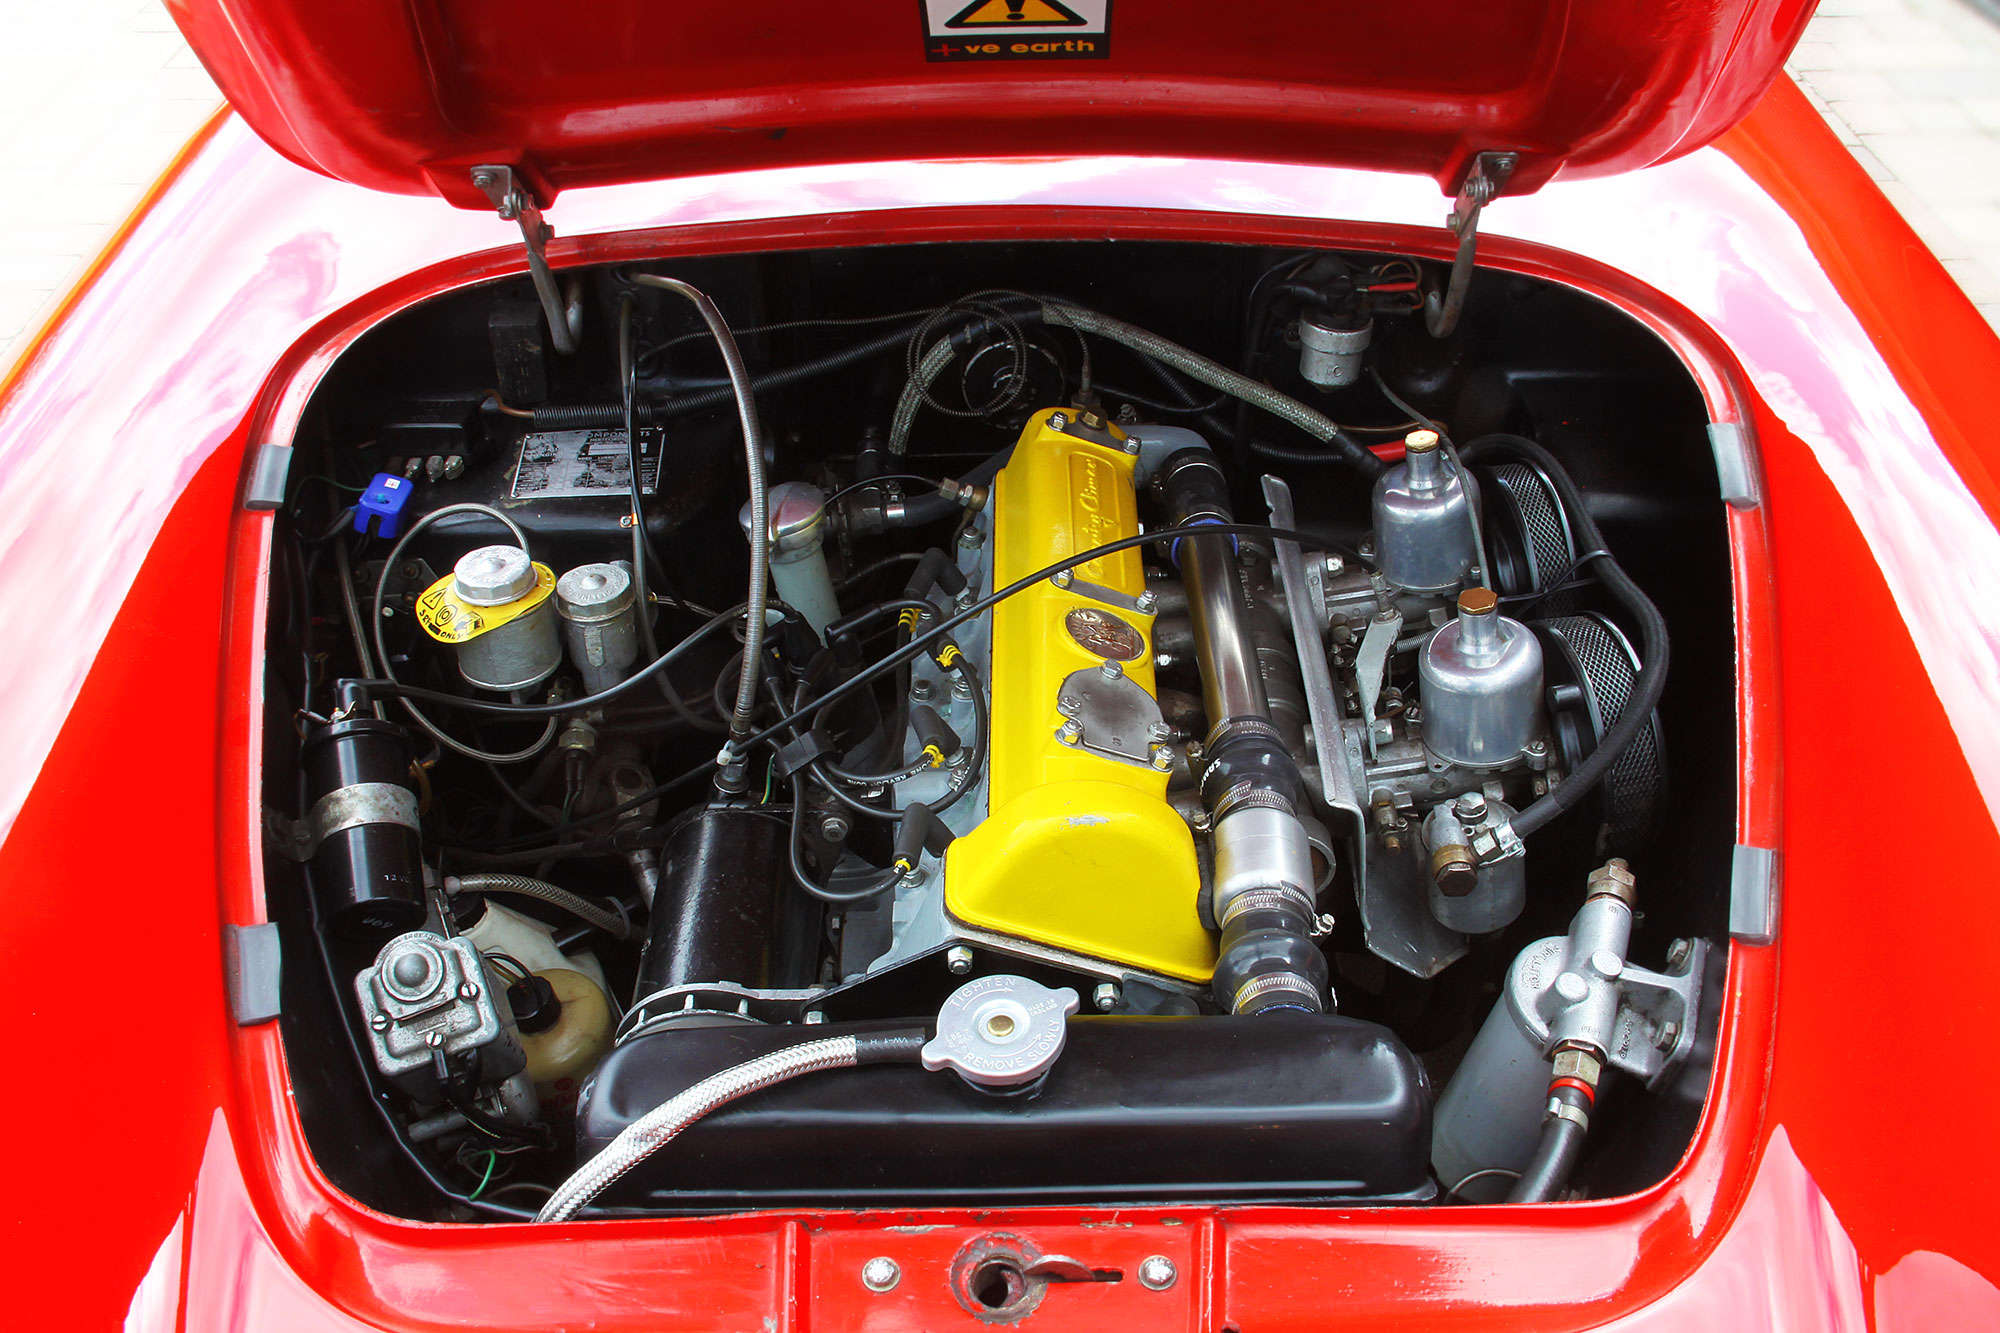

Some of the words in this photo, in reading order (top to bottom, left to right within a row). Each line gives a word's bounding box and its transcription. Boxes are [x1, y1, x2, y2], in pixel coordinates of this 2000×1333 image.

[1010, 40, 1095, 54] earth
[948, 976, 1017, 1007] TIGHTEN
[963, 1052, 1028, 1071] REMOVE
[1029, 1016, 1062, 1061] SLOWLY
